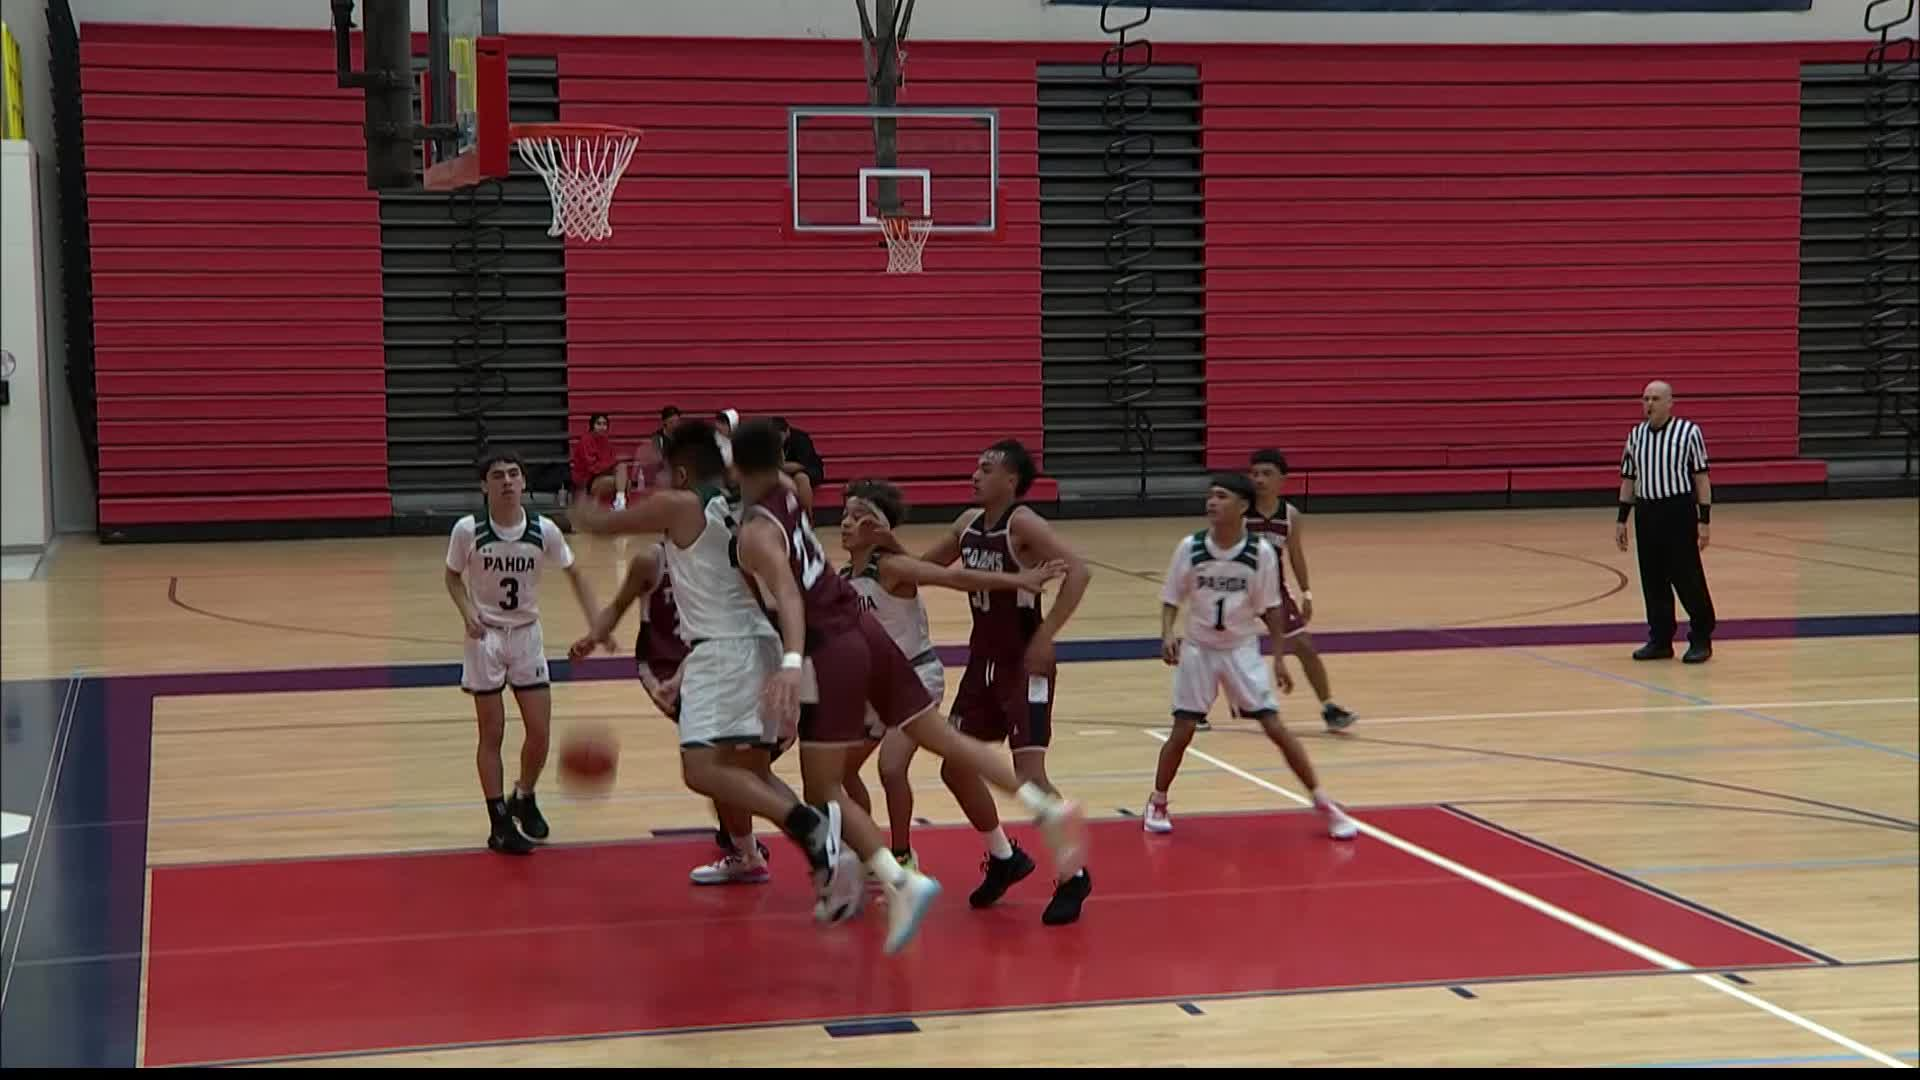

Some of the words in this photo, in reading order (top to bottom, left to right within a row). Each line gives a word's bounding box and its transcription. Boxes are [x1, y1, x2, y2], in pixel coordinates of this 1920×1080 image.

[483, 556, 535, 572] PAHOA
[499, 577, 519, 611] 3
[1215, 597, 1226, 631] 1
